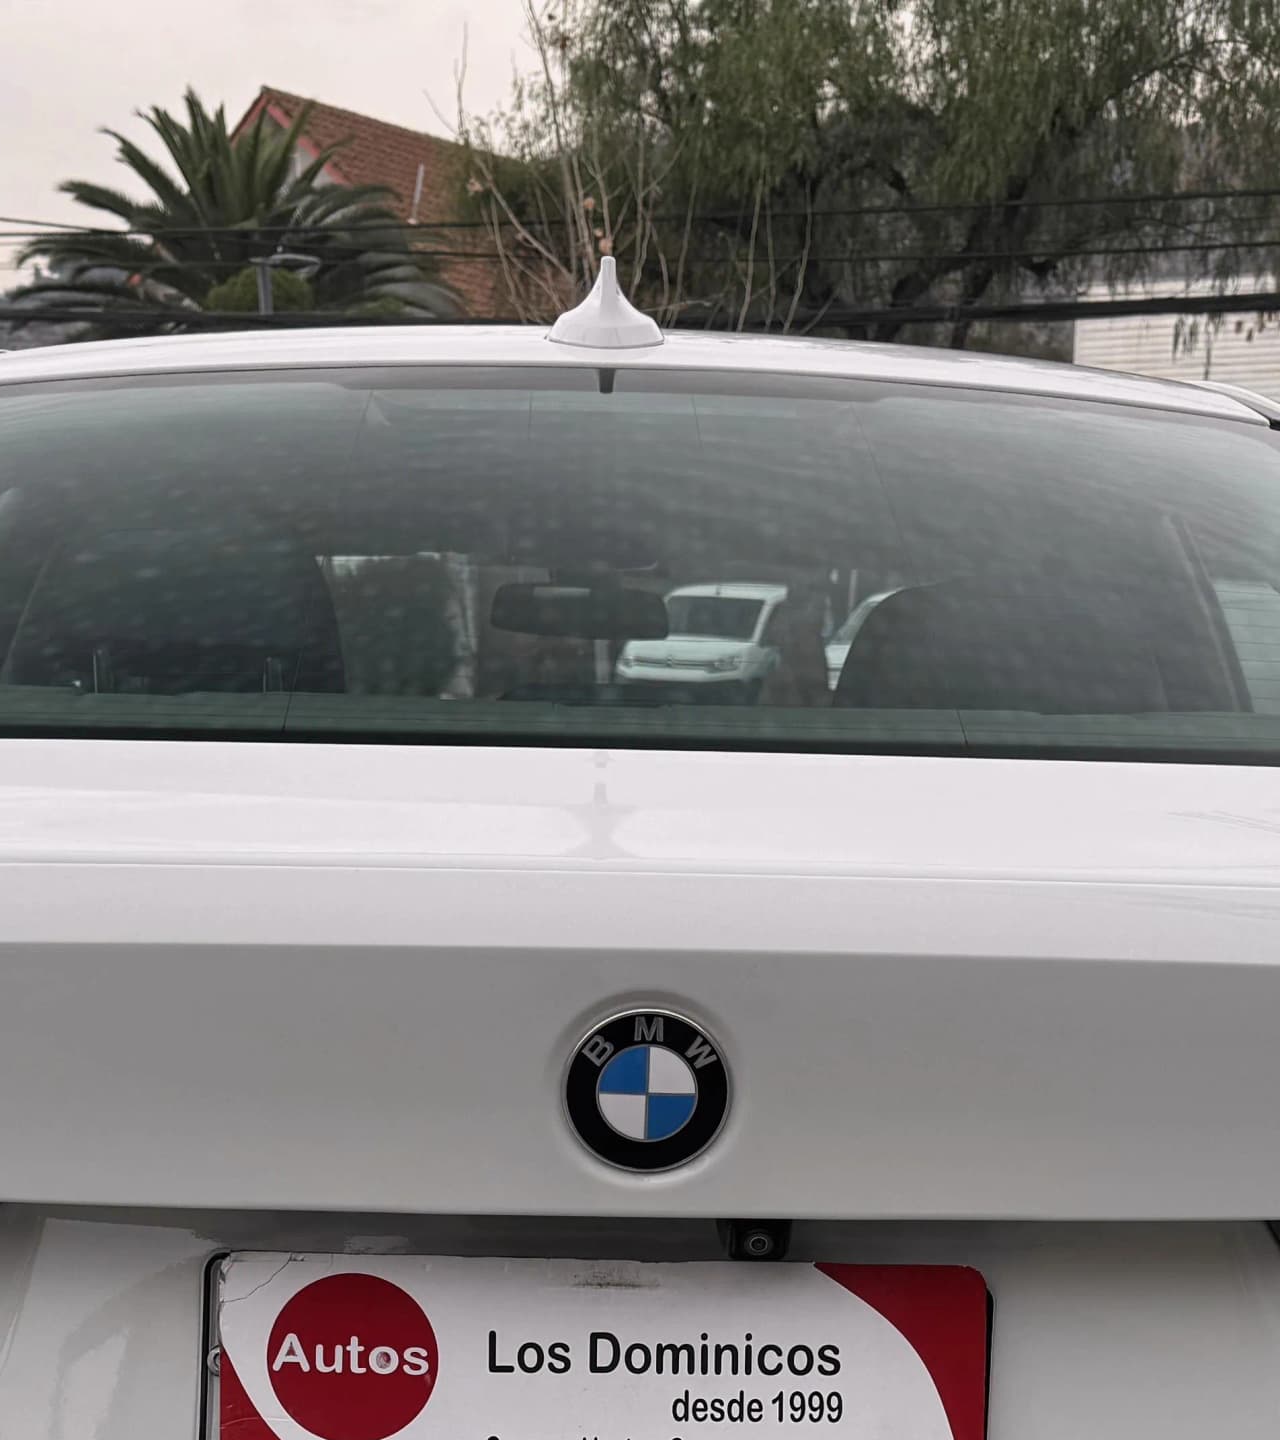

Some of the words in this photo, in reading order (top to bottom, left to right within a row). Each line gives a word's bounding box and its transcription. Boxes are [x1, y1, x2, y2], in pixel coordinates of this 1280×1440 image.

[581, 1016, 718, 1070] BMW
[272, 1333, 430, 1376] Autos
[488, 1330, 571, 1373] Los
[589, 1332, 841, 1376] Dominicos
[672, 1389, 763, 1422] desde
[771, 1391, 843, 1423] 1999
